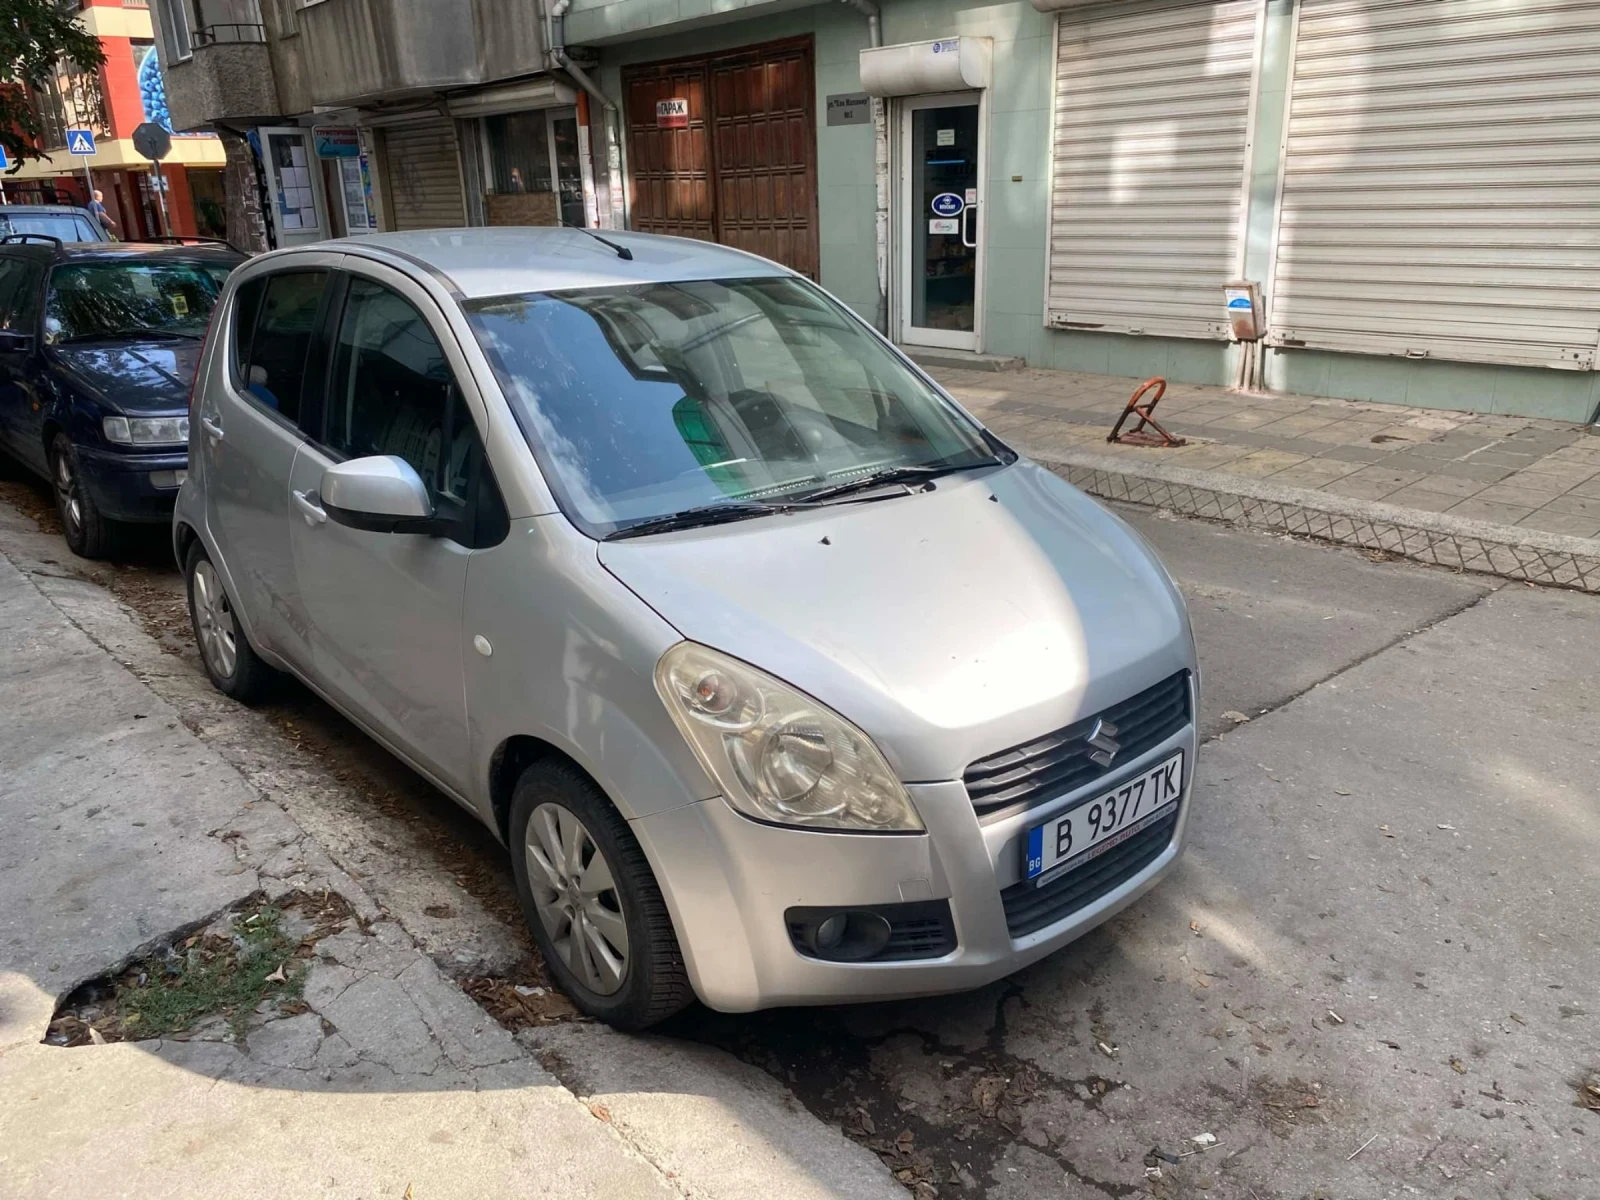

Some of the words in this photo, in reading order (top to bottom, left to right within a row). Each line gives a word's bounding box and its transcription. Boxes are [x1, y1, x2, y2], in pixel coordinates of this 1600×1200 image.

[660, 101, 684, 115] ГАРАЖ
[1056, 818, 1073, 859] B
[1088, 778, 1147, 841] 9377
[1151, 760, 1178, 805] TK
[1087, 837, 1119, 858] LEGEND
[1028, 856, 1041, 873] BG
